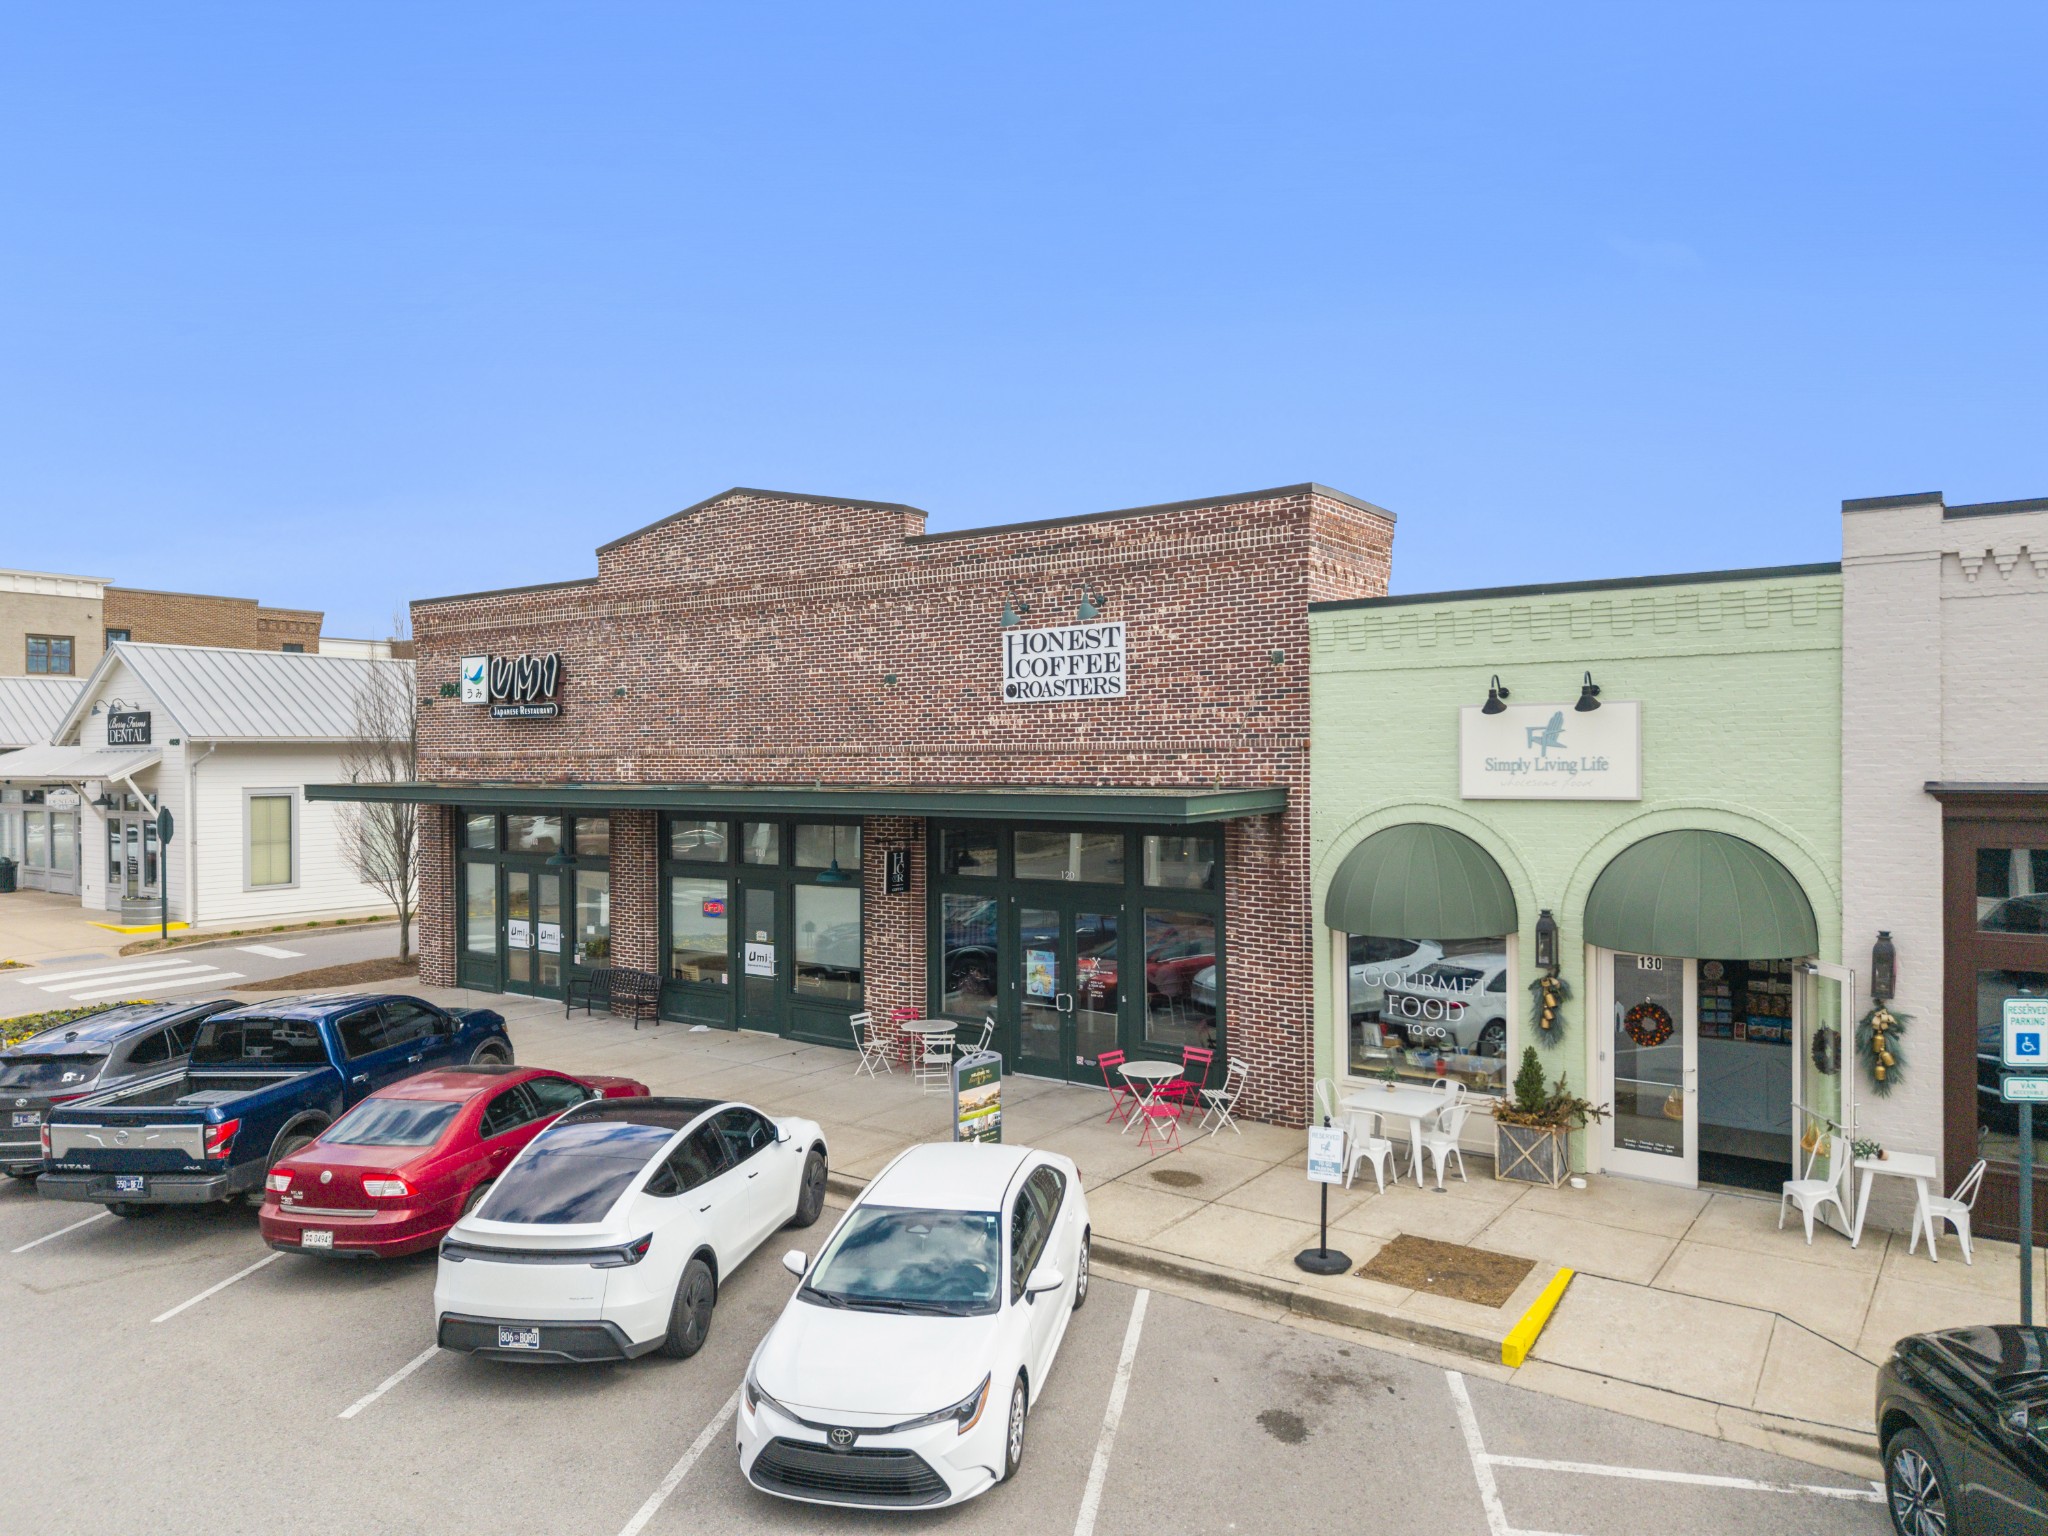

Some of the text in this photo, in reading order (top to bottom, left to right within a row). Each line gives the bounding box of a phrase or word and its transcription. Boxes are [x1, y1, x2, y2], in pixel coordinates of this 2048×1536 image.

[1015, 652, 1120, 679] COFFEE
[490, 652, 557, 701] UMI
[467, 688, 482, 699] うみ
[1016, 676, 1120, 699] ROASTERS
[109, 729, 145, 743] DENTAL
[1485, 756, 1609, 775] Simply Living Life
[1061, 870, 1075, 880] 120
[703, 902, 725, 913] OPEN
[511, 927, 525, 937] Umi
[541, 930, 556, 940] Umi
[748, 951, 768, 963] Umi
[1640, 956, 1662, 970] 130
[1362, 966, 1491, 997] GOURMET
[1388, 995, 1465, 1022] FOOD
[2008, 1006, 2048, 1015] RESERVED
[2010, 1018, 2045, 1026] PARKING
[1406, 1024, 1447, 1038] TO GO
